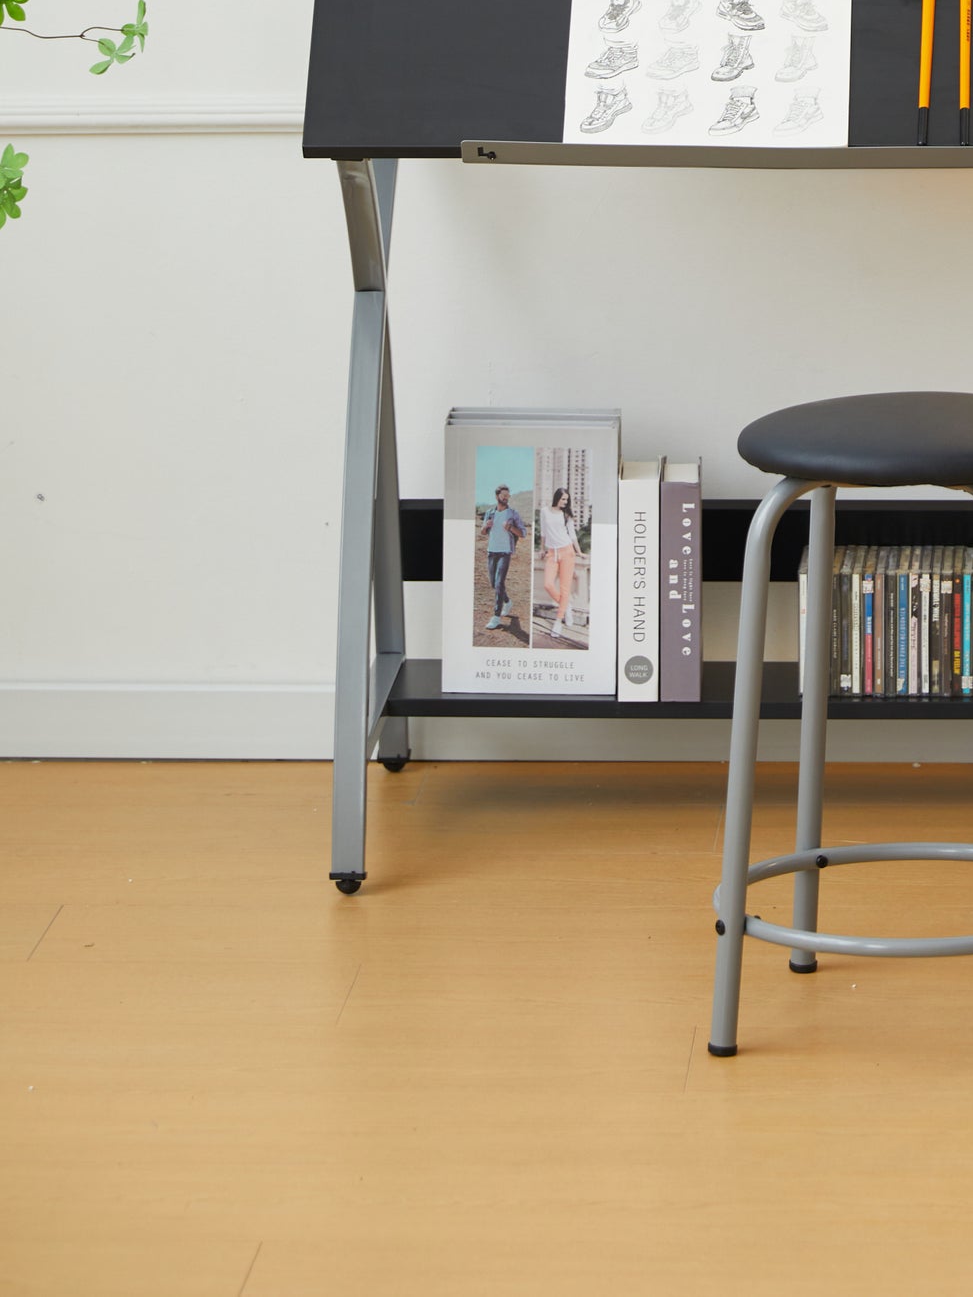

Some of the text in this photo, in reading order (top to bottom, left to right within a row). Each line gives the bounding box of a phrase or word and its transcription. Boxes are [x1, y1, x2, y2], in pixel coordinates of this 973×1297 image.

[682, 503, 695, 555] Love
[632, 511, 647, 643] HOLDER'S HAND
[669, 559, 682, 600] and
[682, 603, 695, 656] Love
[475, 671, 585, 682] AND YOU CEASE TO LIVE
[486, 658, 576, 670] CEASE TO STRUGGLE
